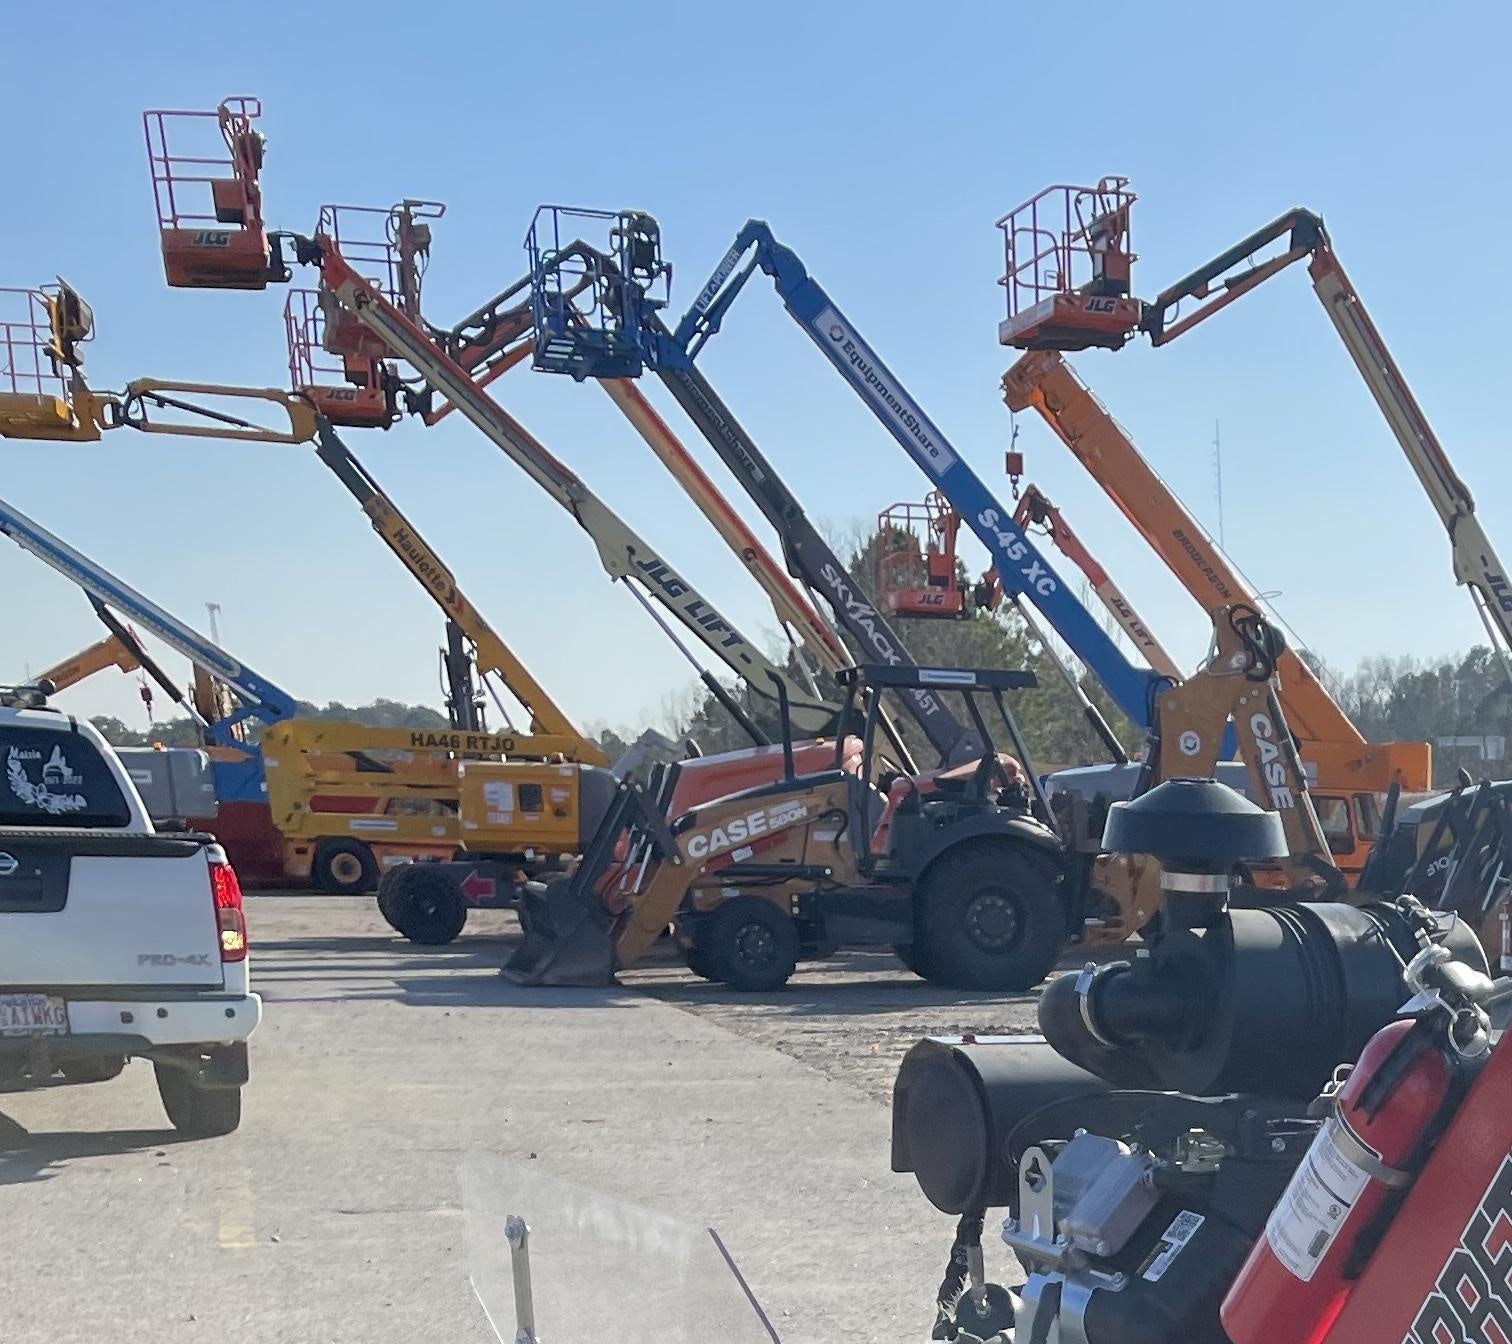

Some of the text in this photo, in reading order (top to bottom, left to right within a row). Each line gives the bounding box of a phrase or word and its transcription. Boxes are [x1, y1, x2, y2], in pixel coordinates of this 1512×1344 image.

[193, 231, 229, 246] JLG
[1085, 298, 1116, 312] JLG
[842, 339, 940, 459] EquipmentShare
[393, 527, 446, 591] Haulotte
[977, 508, 1057, 596] S-45 XC
[636, 559, 745, 648] JLG LIFT
[820, 563, 902, 667] SKYJACK
[918, 593, 945, 605] JLG
[411, 732, 460, 749] HA46
[1250, 712, 1295, 809] CASE
[687, 810, 767, 858] CASE
[137, 954, 212, 967] PRO-4X
